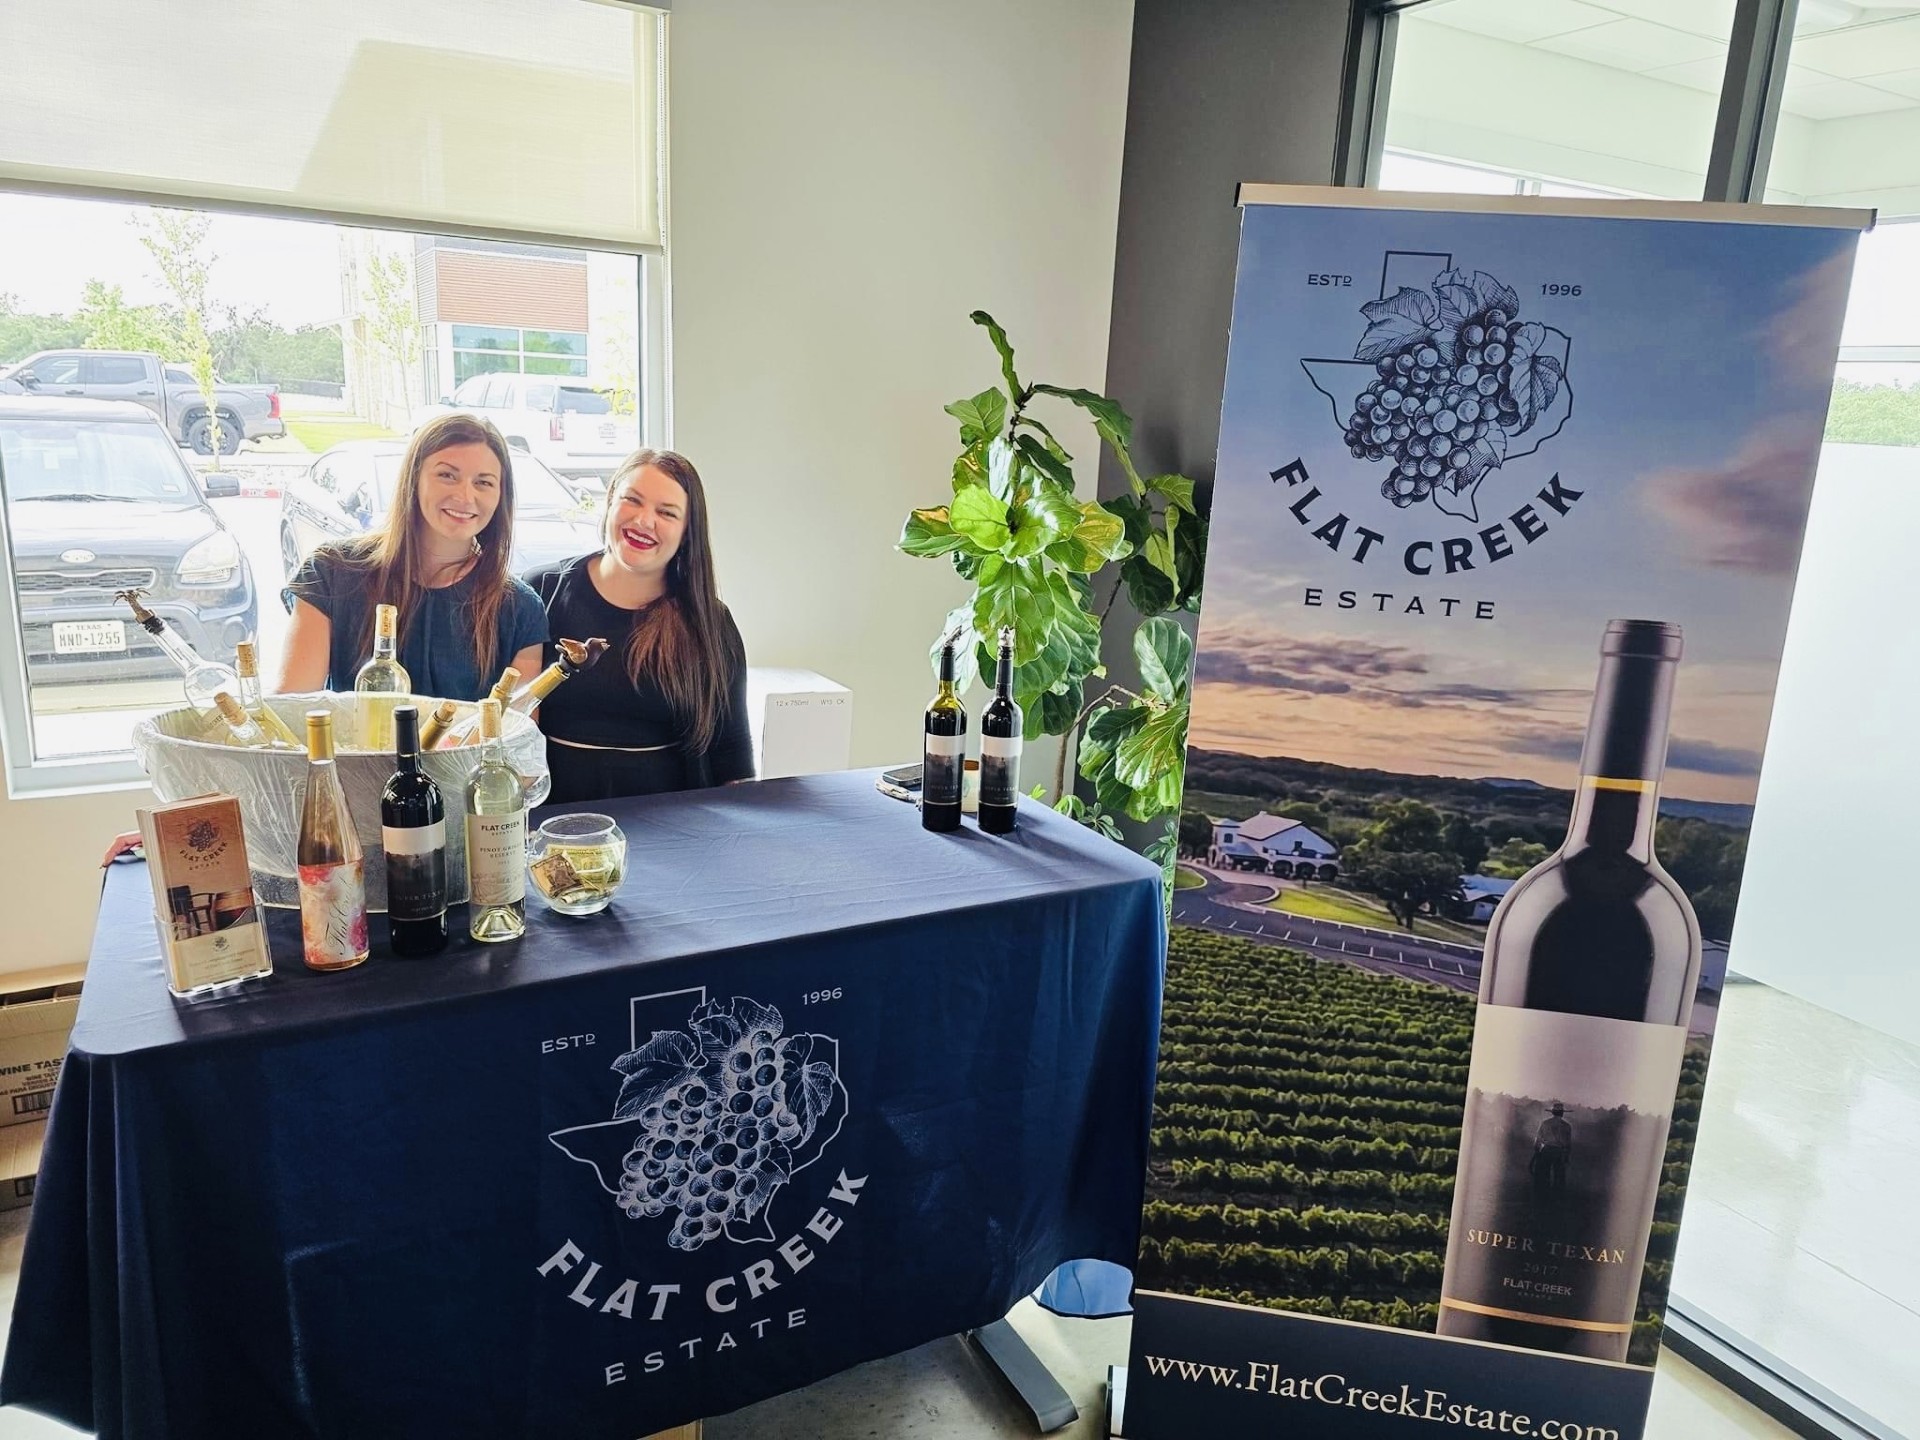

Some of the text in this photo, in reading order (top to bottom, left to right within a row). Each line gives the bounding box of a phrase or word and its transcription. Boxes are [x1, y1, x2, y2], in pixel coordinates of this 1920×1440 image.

[1540, 283, 1583, 298] 1996
[1269, 456, 1585, 576] FLAT CREEK
[1304, 588, 1497, 620] ESTATE
[481, 820, 520, 832] FLAT CREEK
[180, 849, 199, 863] FLAT
[801, 986, 844, 1006] 1996
[537, 1167, 869, 1321] FLAT CREEK
[1467, 1228, 1626, 1265] SUPER TEXAN
[1523, 1262, 1560, 1276] 2017
[1503, 1277, 1574, 1297] FLAT CREEK
[605, 1307, 808, 1387] ESTATE
[1145, 1354, 1620, 1440] www.FlatCreekEstate.com
